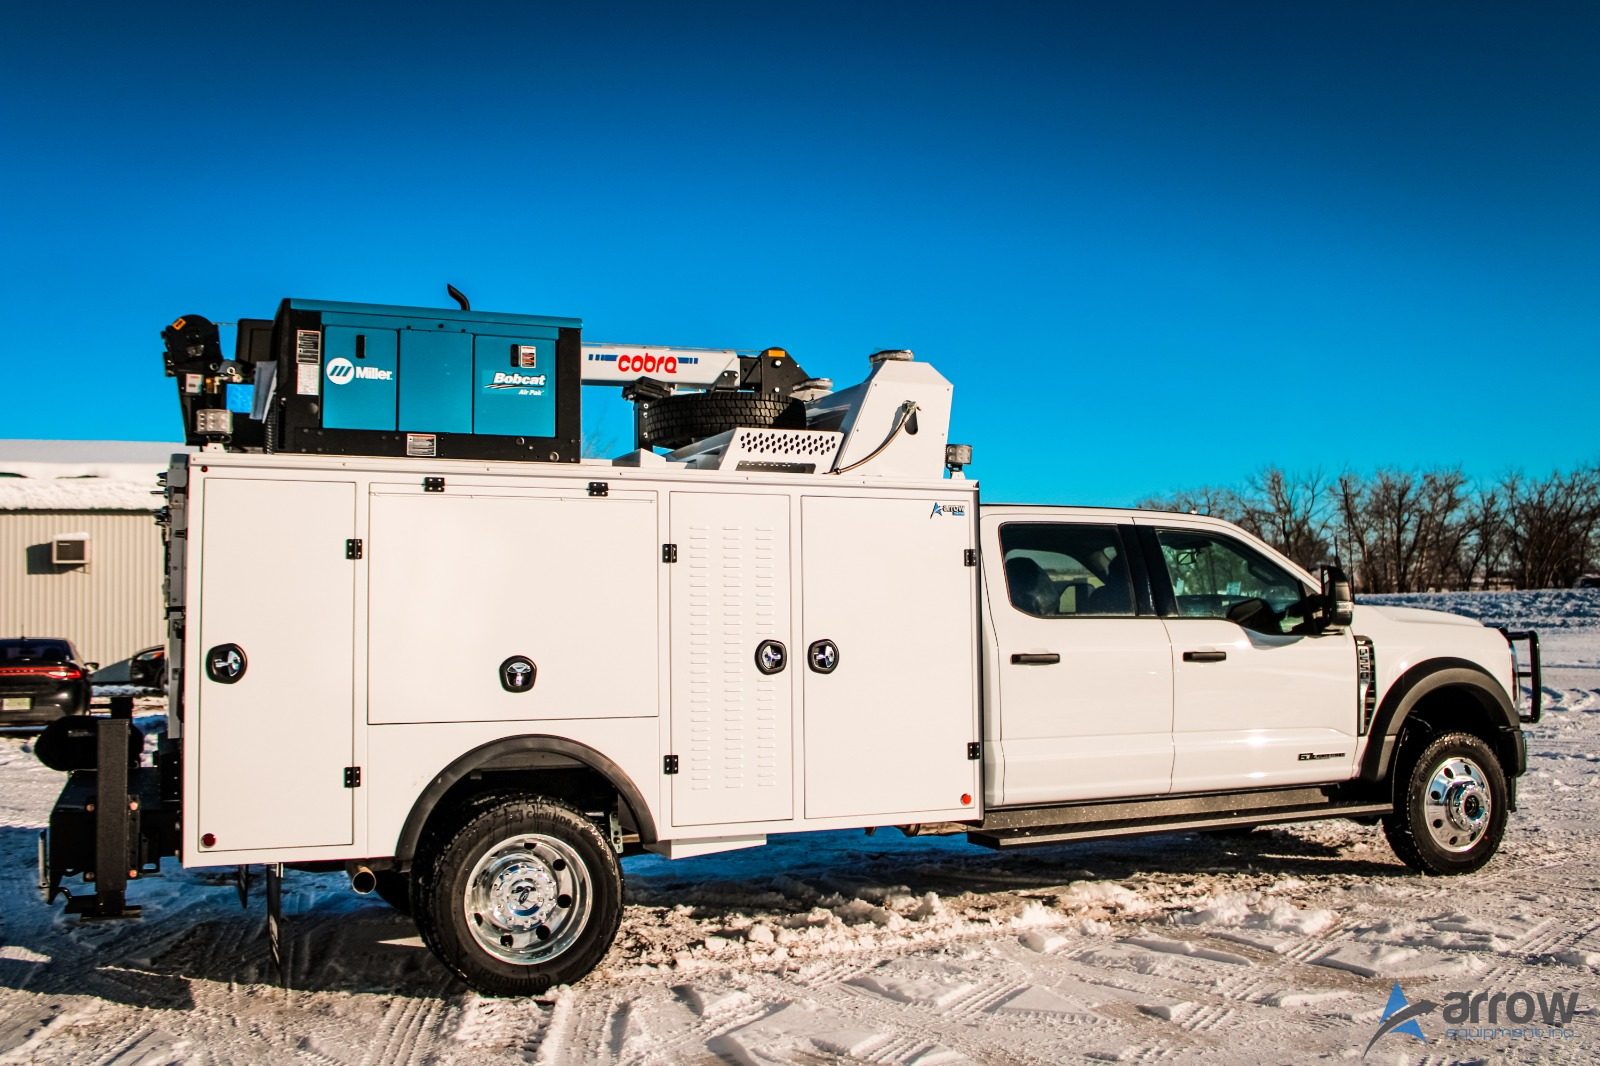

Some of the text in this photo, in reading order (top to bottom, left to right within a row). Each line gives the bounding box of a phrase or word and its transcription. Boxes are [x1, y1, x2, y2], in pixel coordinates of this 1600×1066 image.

[618, 353, 677, 374] cobra
[355, 366, 393, 381] Miller
[493, 372, 546, 386] Bobcat
